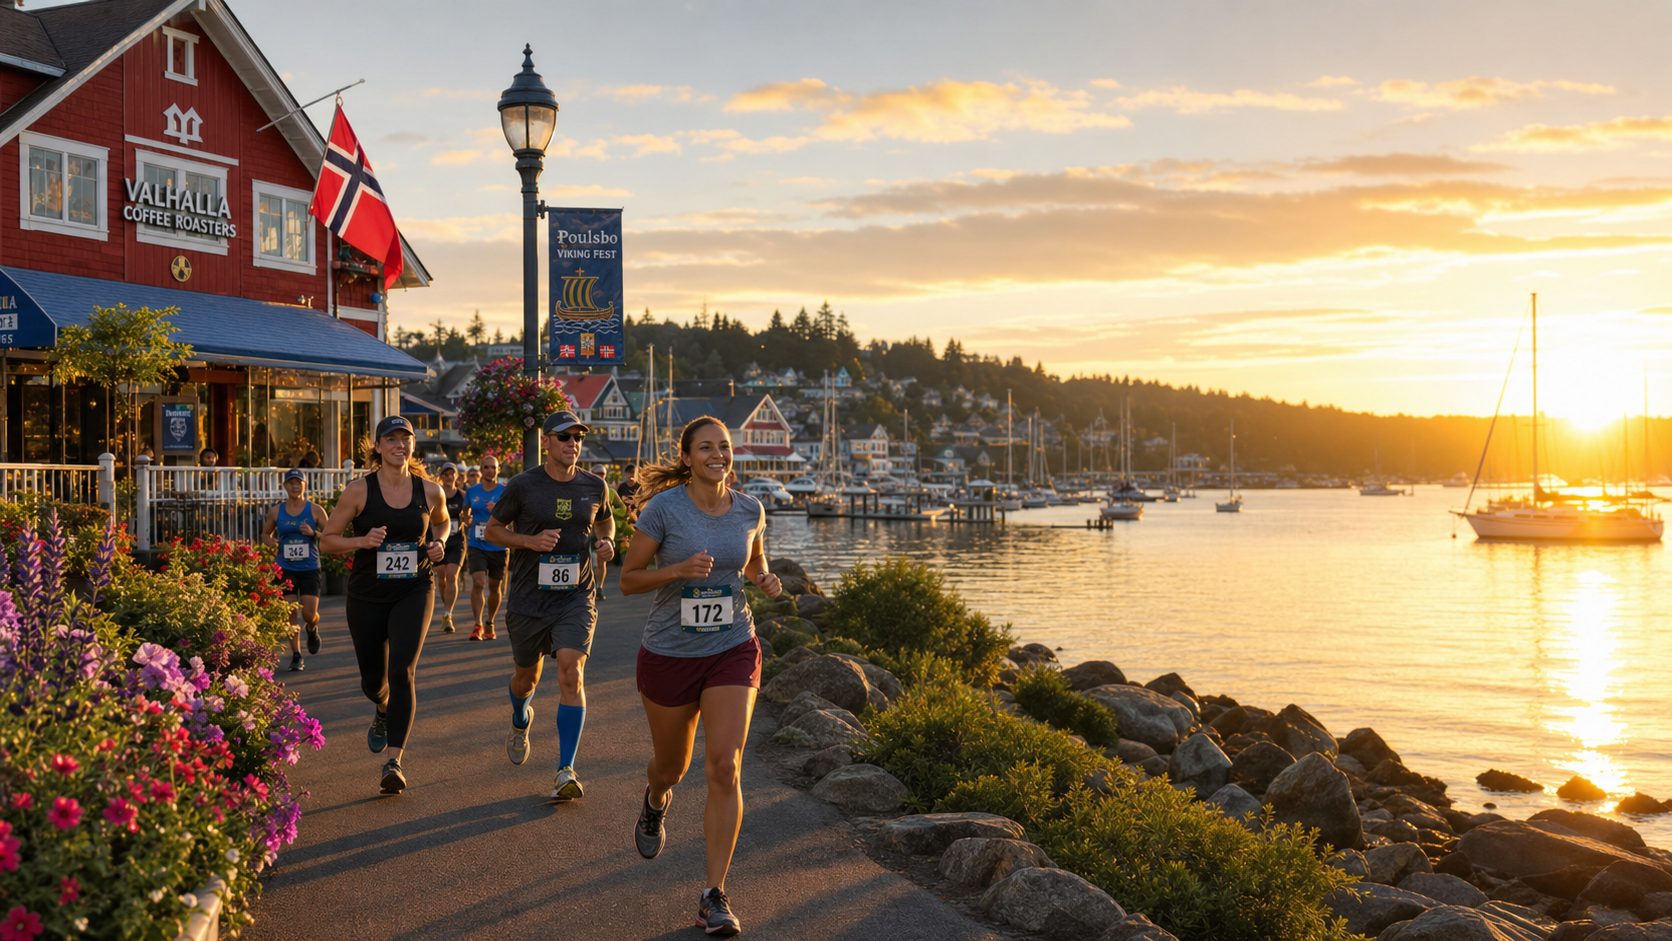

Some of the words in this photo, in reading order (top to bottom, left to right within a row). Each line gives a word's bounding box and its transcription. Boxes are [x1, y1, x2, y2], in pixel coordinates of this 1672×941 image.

[124, 177, 232, 219] VALHALLA
[123, 205, 171, 227] COFFEE
[175, 214, 237, 238] ROASTERS
[557, 229, 618, 244] Poulsbo
[557, 249, 591, 259] VIKING
[593, 249, 617, 259] FEST
[386, 556, 410, 571] 242
[552, 568, 570, 583] 86
[692, 604, 723, 623] 172
